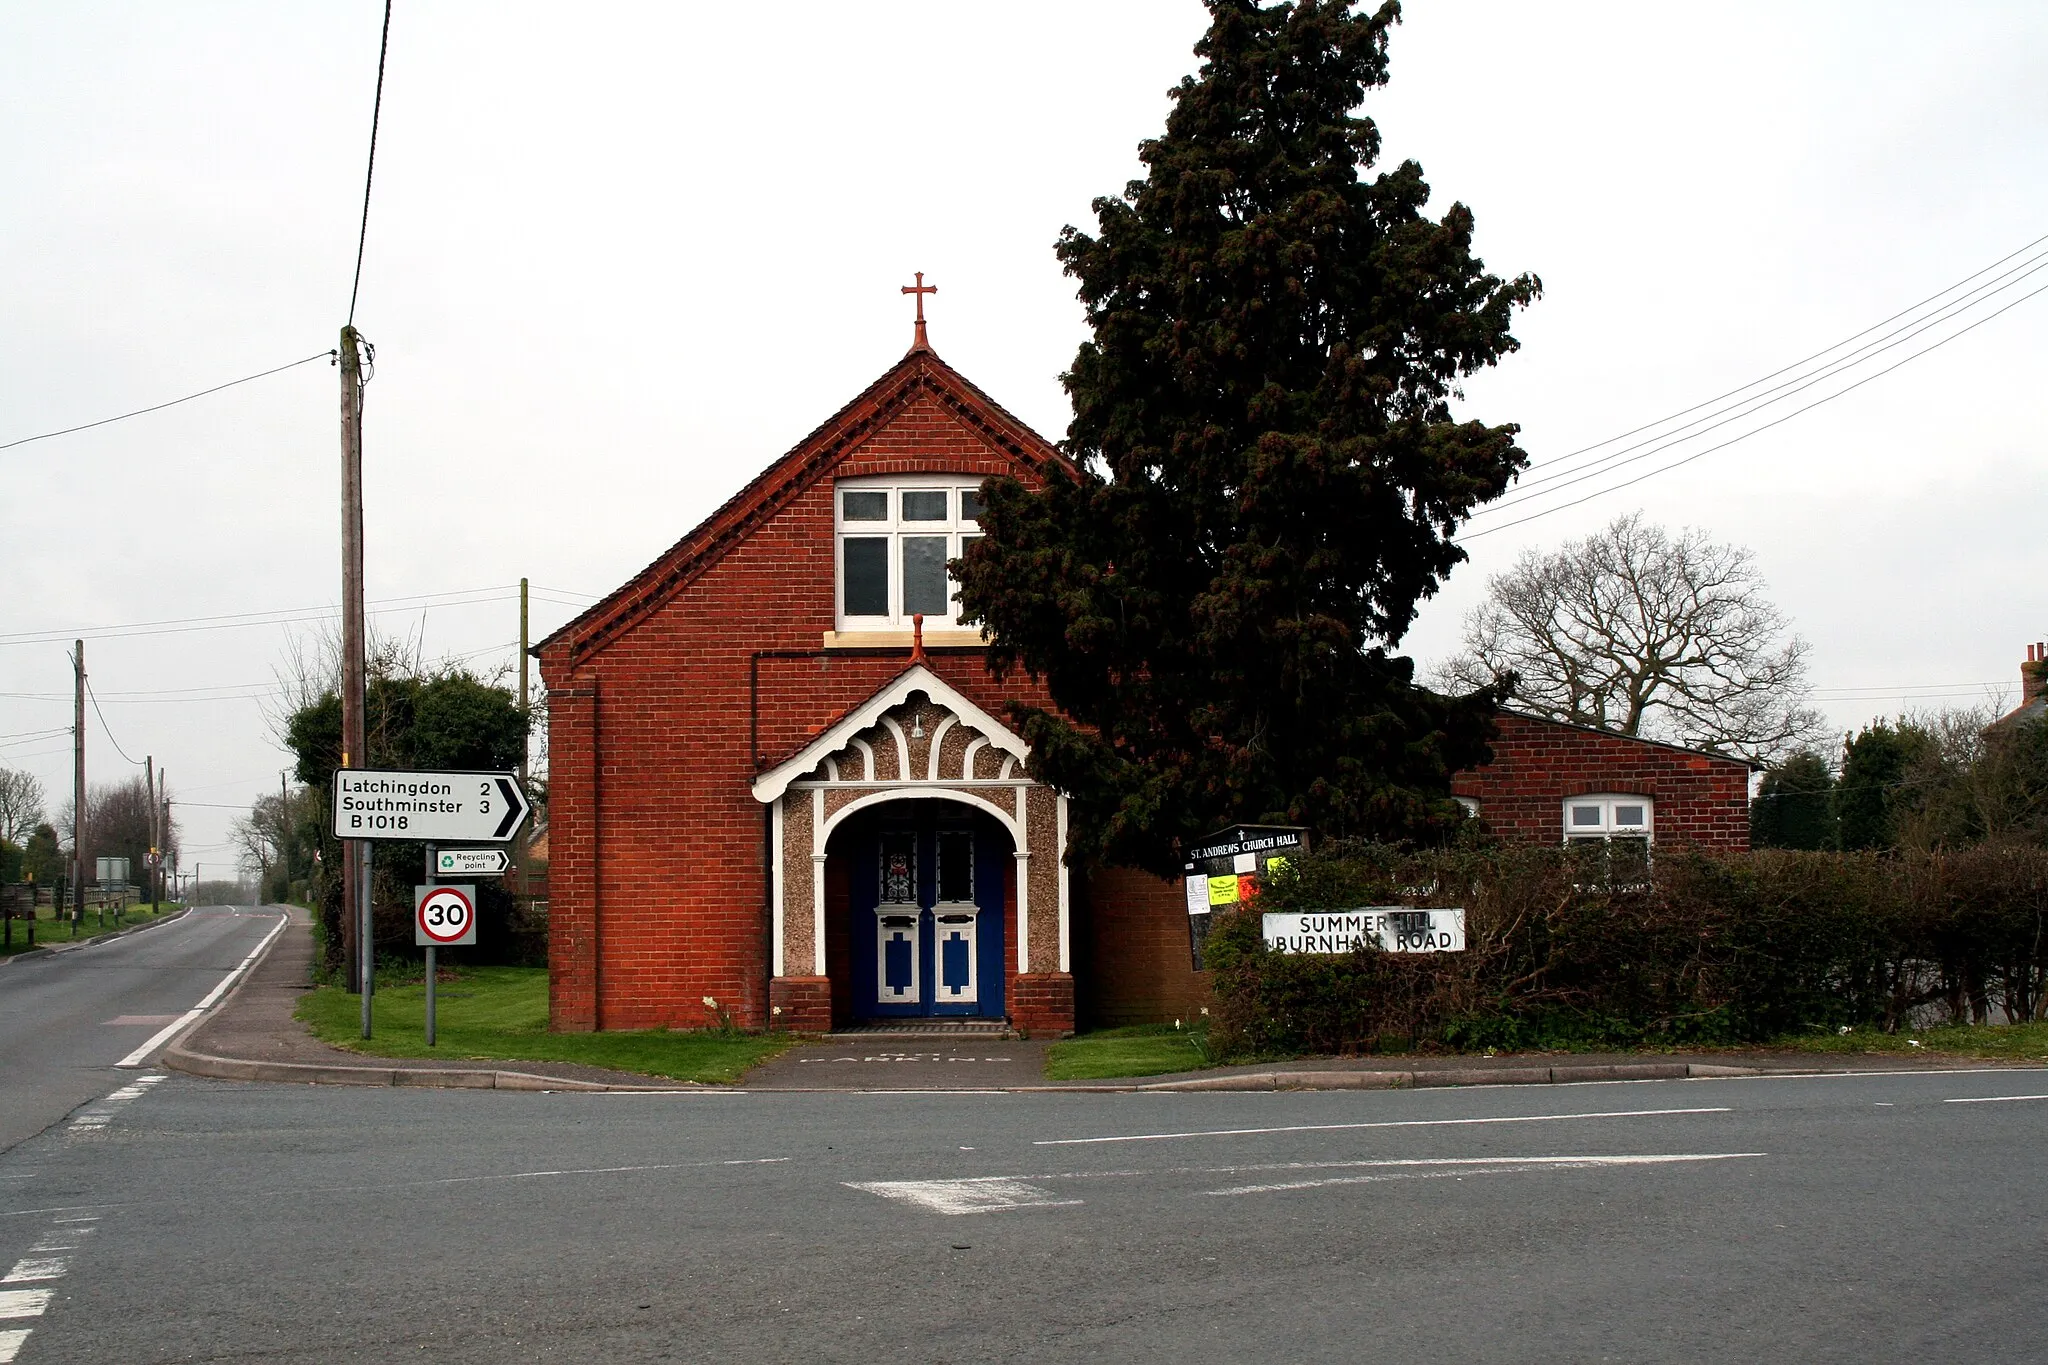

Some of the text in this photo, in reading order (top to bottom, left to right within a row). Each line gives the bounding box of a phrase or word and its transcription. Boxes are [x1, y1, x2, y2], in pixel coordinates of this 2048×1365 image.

[343, 779, 490, 796] Latchingdon 2
[343, 797, 490, 814] Southminster 3
[351, 815, 408, 829] B 1018
[1242, 837, 1274, 851] CHURCH
[1276, 833, 1298, 846] HALL
[456, 853, 496, 862] Recycling
[428, 904, 464, 926] 30
